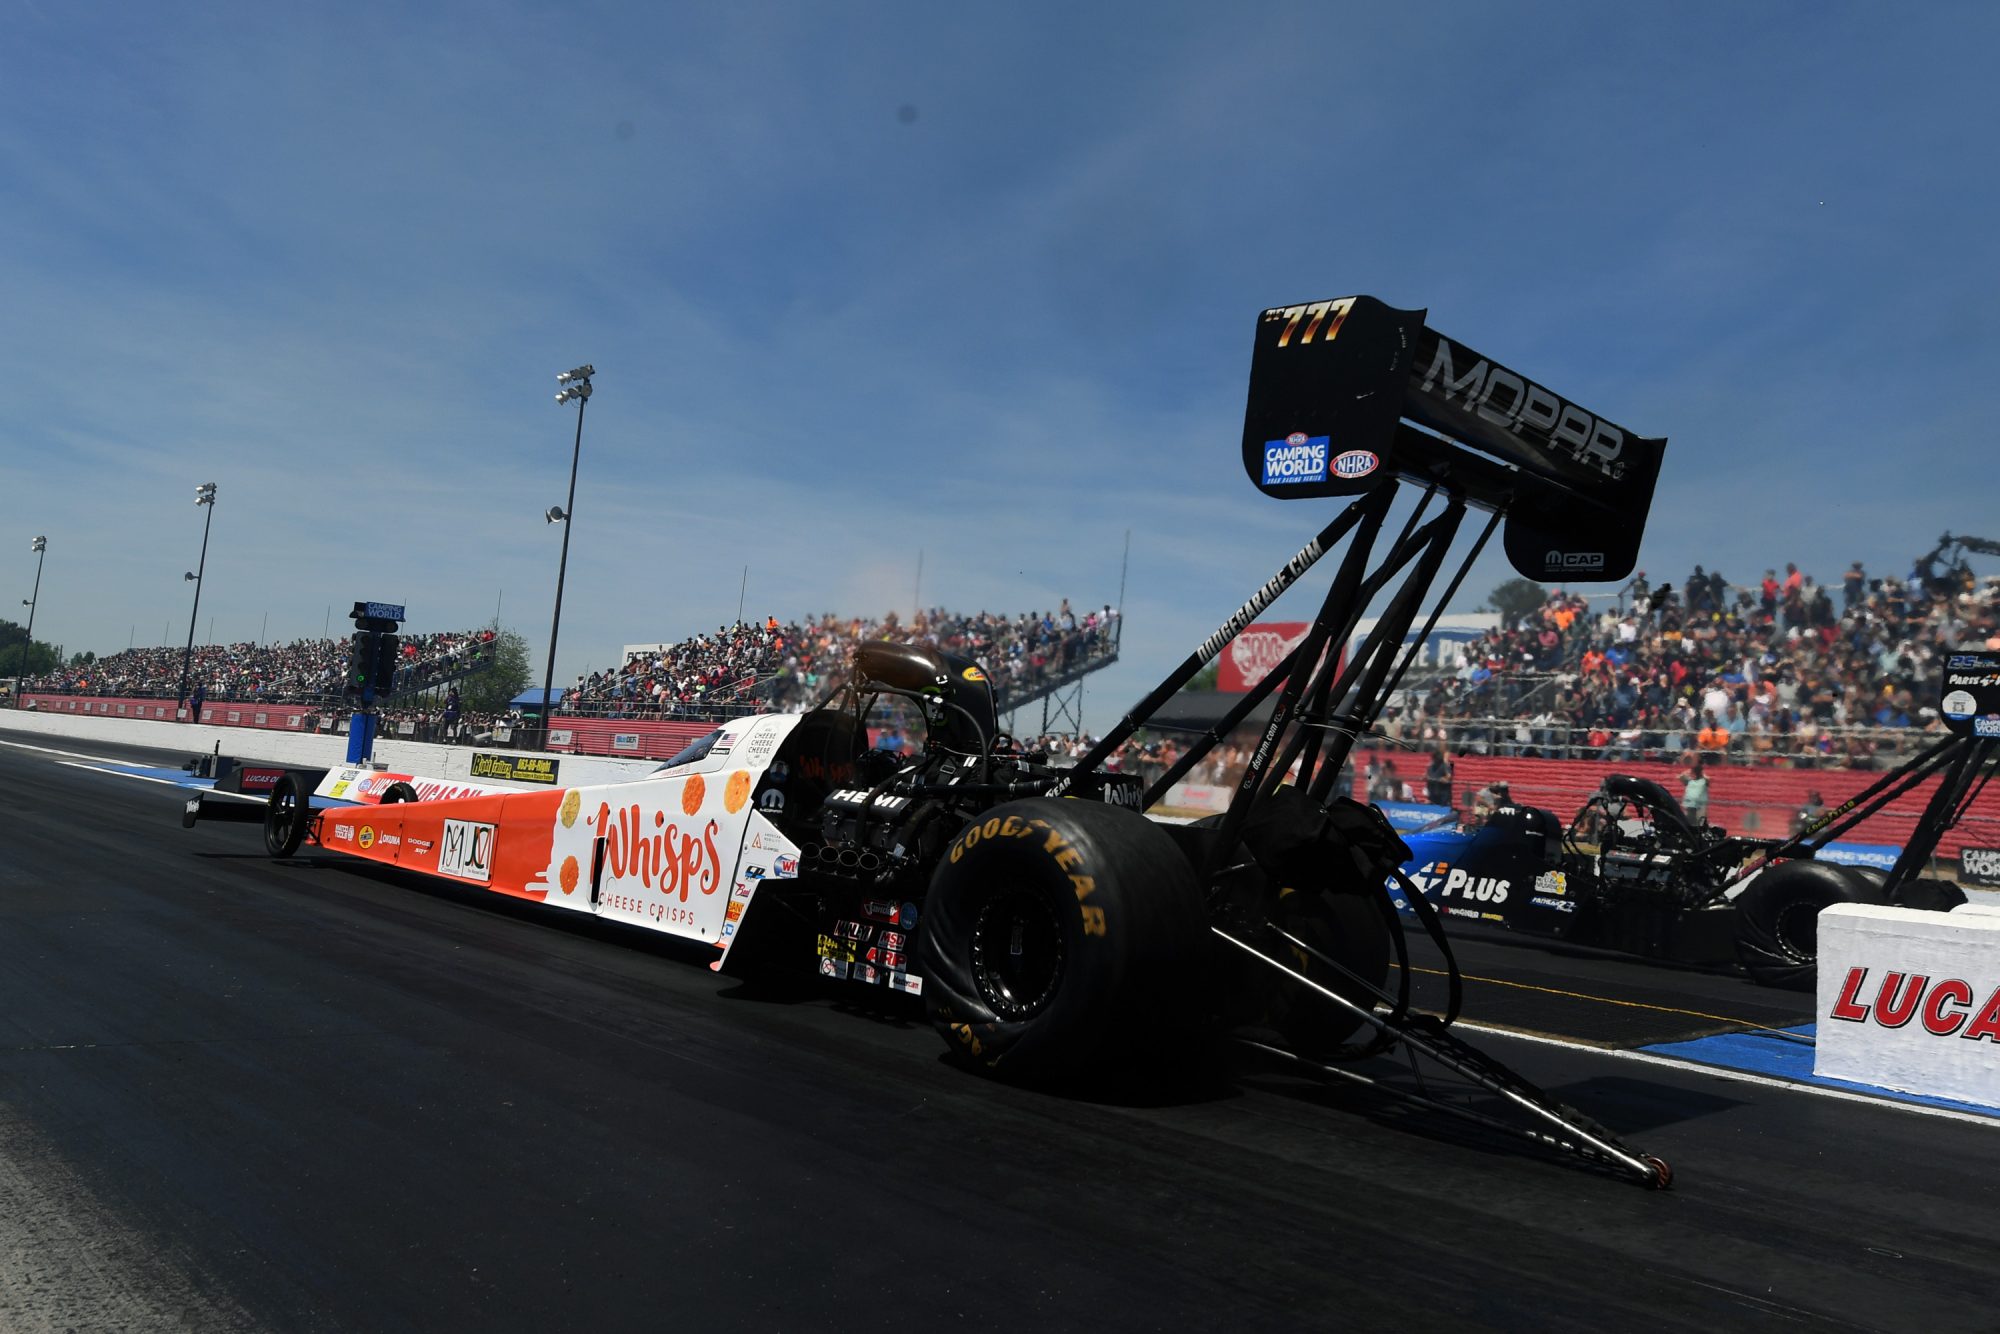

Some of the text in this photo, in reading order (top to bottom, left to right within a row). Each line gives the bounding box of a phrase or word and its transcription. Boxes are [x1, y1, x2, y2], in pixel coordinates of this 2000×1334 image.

[1278, 297, 1357, 348] 777
[1421, 338, 1624, 477] MOPAR
[1266, 445, 1325, 462] CAMPING
[1266, 458, 1325, 477] WORLD
[1337, 455, 1372, 474] NHRA
[368, 602, 402, 612] CAMPING
[1196, 536, 1323, 664] DODGEGARAGE.COM
[368, 608, 401, 620] WORLD
[1974, 718, 2000, 729] CAMPI
[1976, 726, 2000, 734] WOR
[751, 739, 773, 747] CHEESE
[754, 732, 777, 740] CHEESE
[748, 746, 771, 754] CHEESE
[245, 774, 270, 783] LUCAS
[832, 789, 905, 809] HEMI
[407, 837, 431, 847] DODGE
[587, 802, 721, 903] Whisps
[1857, 852, 1897, 865] WORLD
[1963, 850, 2000, 863] CAMP
[1963, 861, 2000, 877] WOR
[1441, 868, 1511, 904] PLUS
[599, 892, 695, 926] CHEESE CRISPS
[880, 931, 904, 945] MSD
[866, 947, 906, 968] ARP
